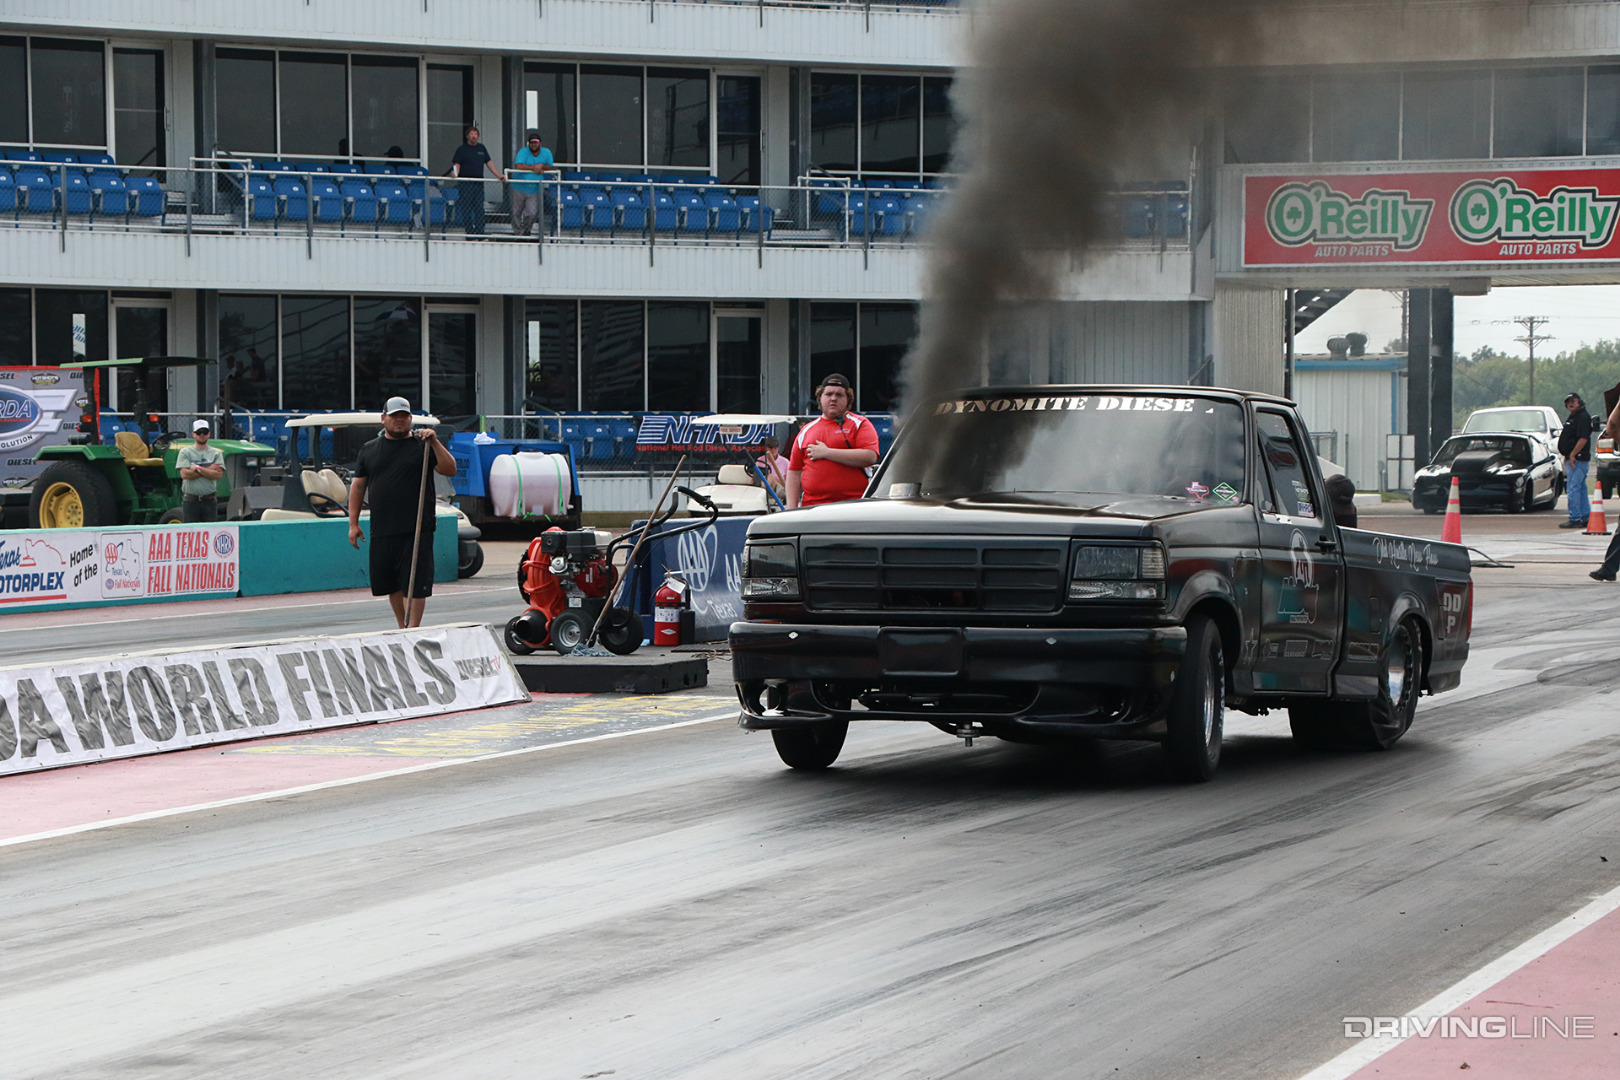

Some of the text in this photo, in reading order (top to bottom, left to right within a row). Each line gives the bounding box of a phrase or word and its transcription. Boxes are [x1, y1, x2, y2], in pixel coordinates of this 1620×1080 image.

[1274, 190, 1422, 241] O'Reilly
[1458, 187, 1611, 239] O'Reilly
[1315, 245, 1389, 257] AUTO PARTS
[1499, 243, 1577, 256] AUTO PARTS
[933, 397, 1214, 416] DYNOMITE DIESE
[70, 544, 93, 567] Home
[148, 531, 209, 561] AAA TEXAS
[74, 568, 83, 587] of
[84, 563, 98, 581] the
[147, 562, 235, 593] FALL NATIONALS
[707, 600, 738, 619] Texas
[54, 658, 280, 751] WORLD
[276, 639, 456, 721] FINALS
